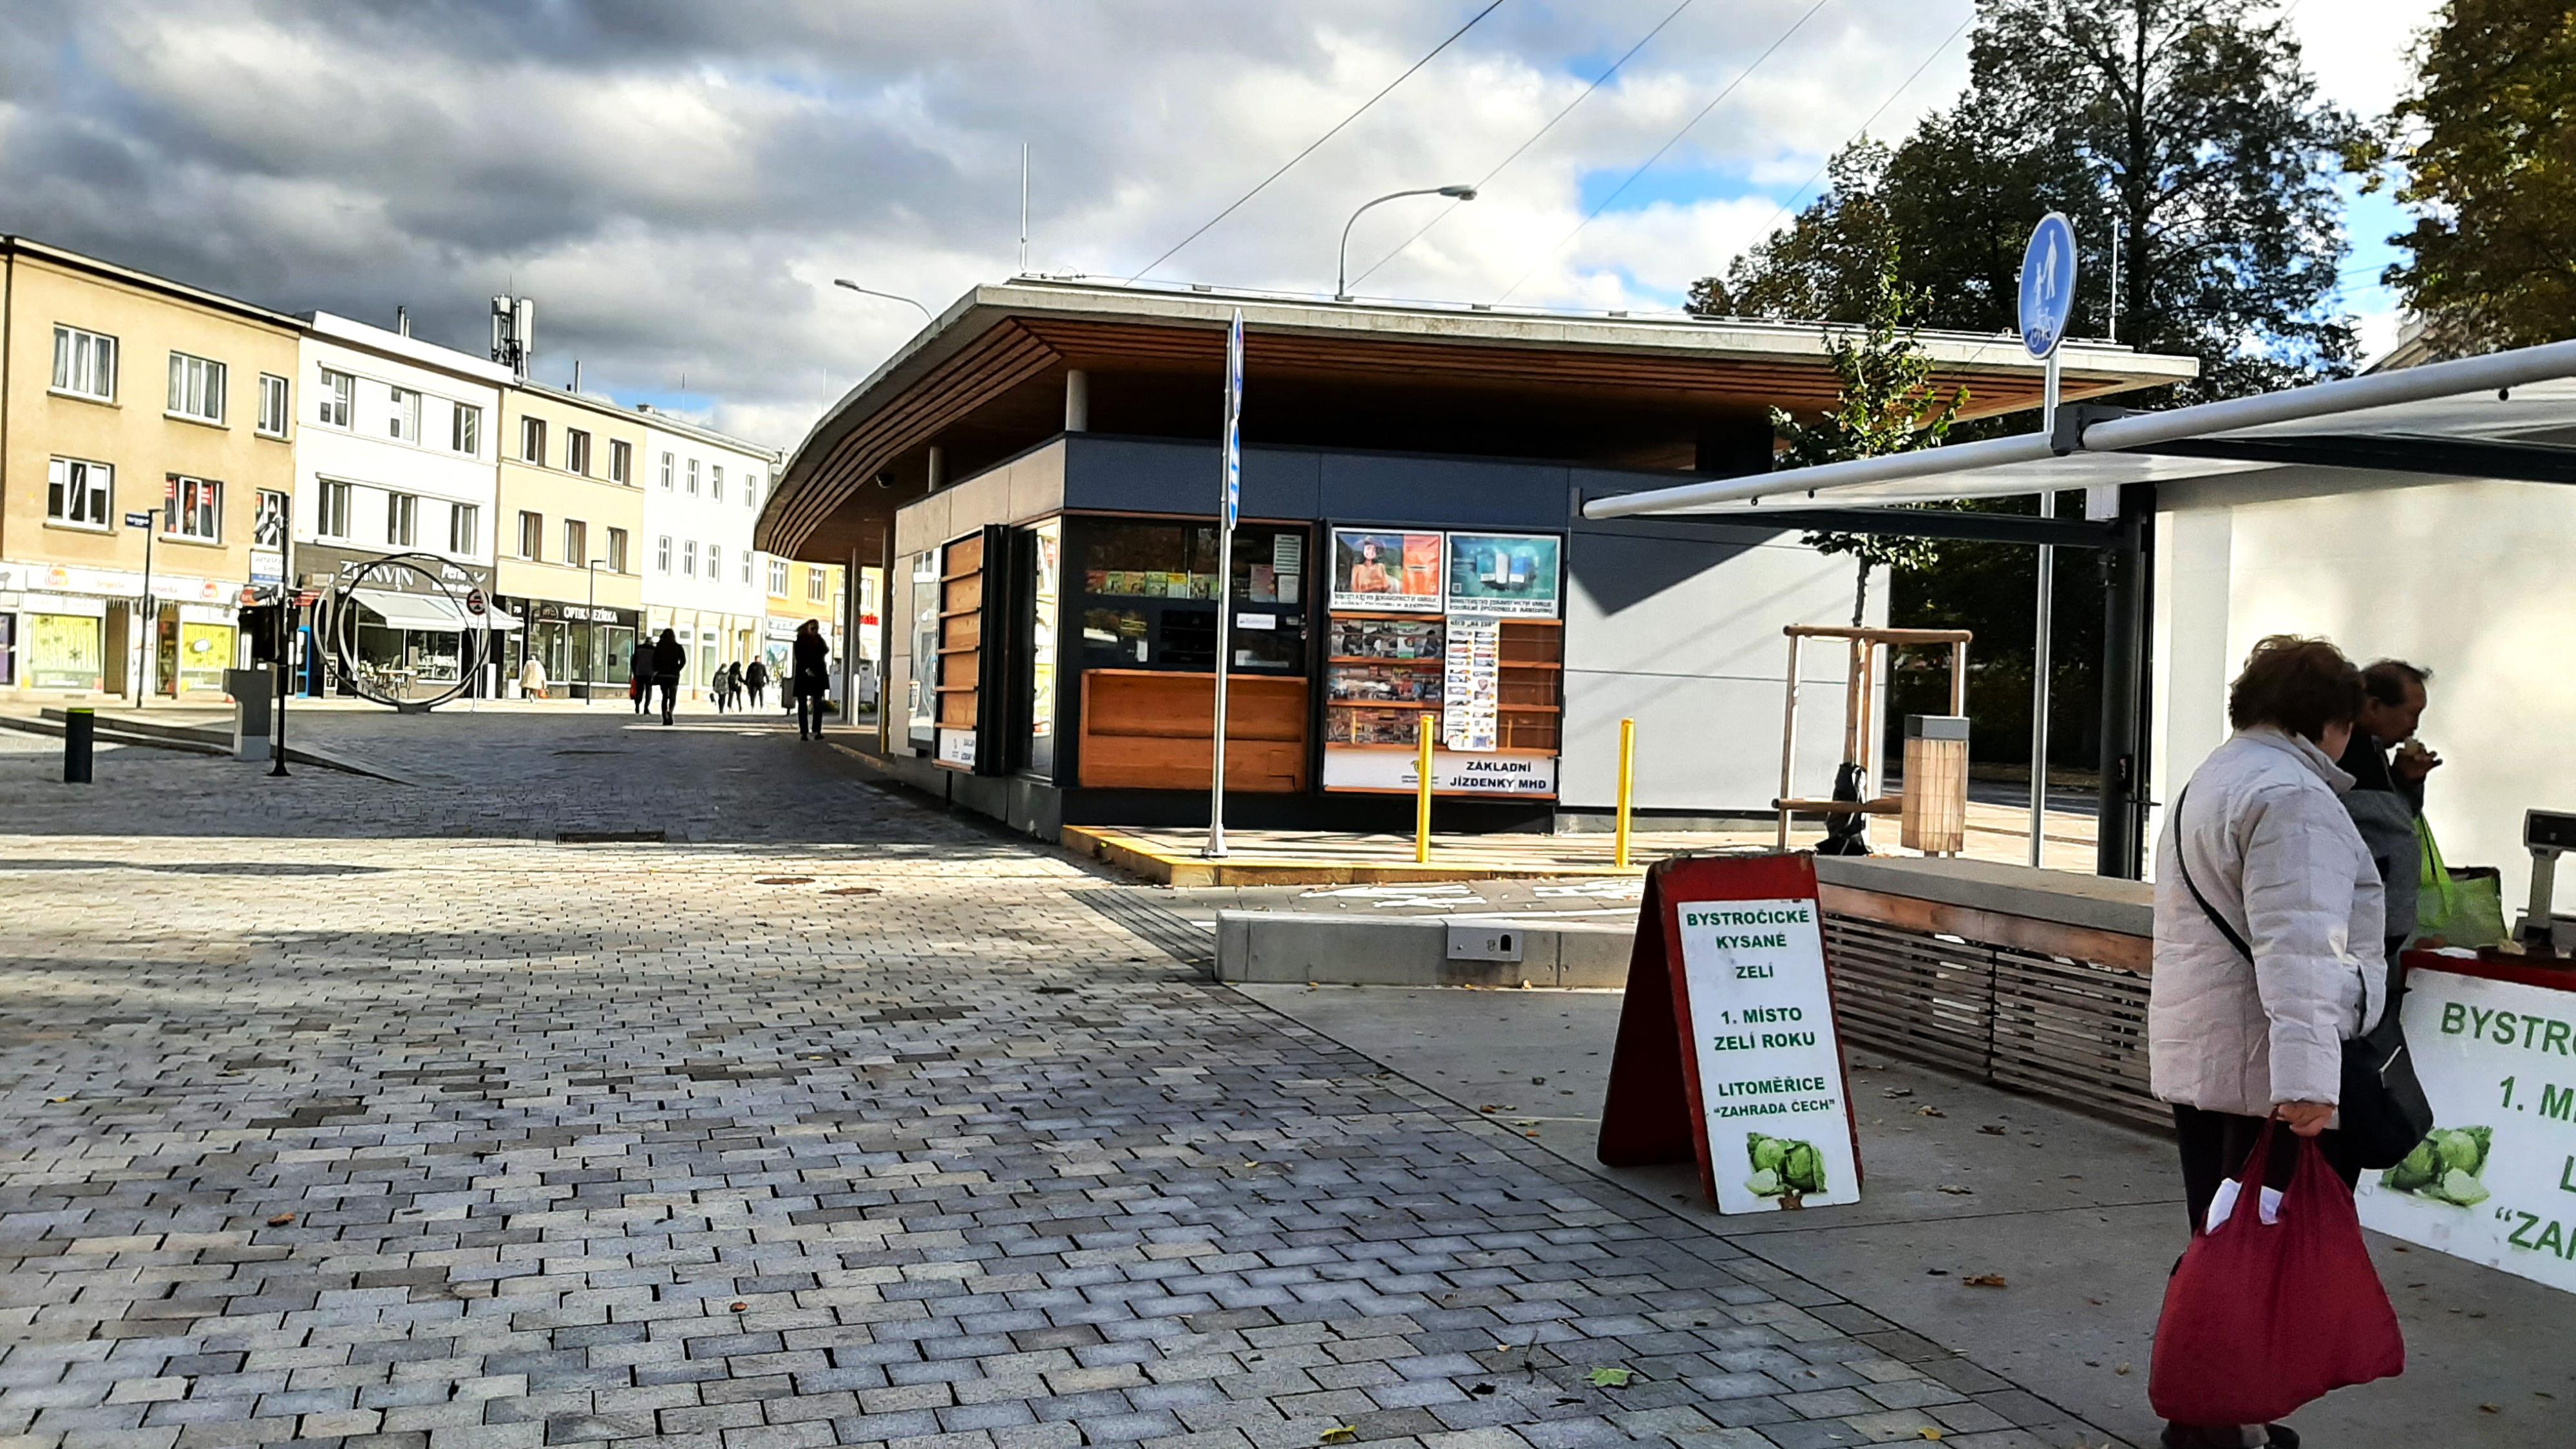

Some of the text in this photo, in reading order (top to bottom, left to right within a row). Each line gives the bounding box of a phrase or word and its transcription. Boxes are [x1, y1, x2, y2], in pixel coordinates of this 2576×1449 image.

[1466, 761, 1531, 772] ZÁKLADNÍ
[1450, 775, 1515, 789] JÍZDENKY
[1519, 779, 1547, 789] MHD
[1687, 907, 1810, 926] BYSTROČICKÉ
[1716, 931, 1786, 949] KYSANÉ
[1736, 961, 1773, 979] ZELÍ
[1721, 1005, 1802, 1025] 1. MÍSTO
[2441, 1002, 2576, 1056] BYSTR
[1714, 1032, 1815, 1050] ZELÍ ROKU
[1718, 1076, 1825, 1096] LITOMĚŘICE
[2500, 1076, 2576, 1124] 1. M
